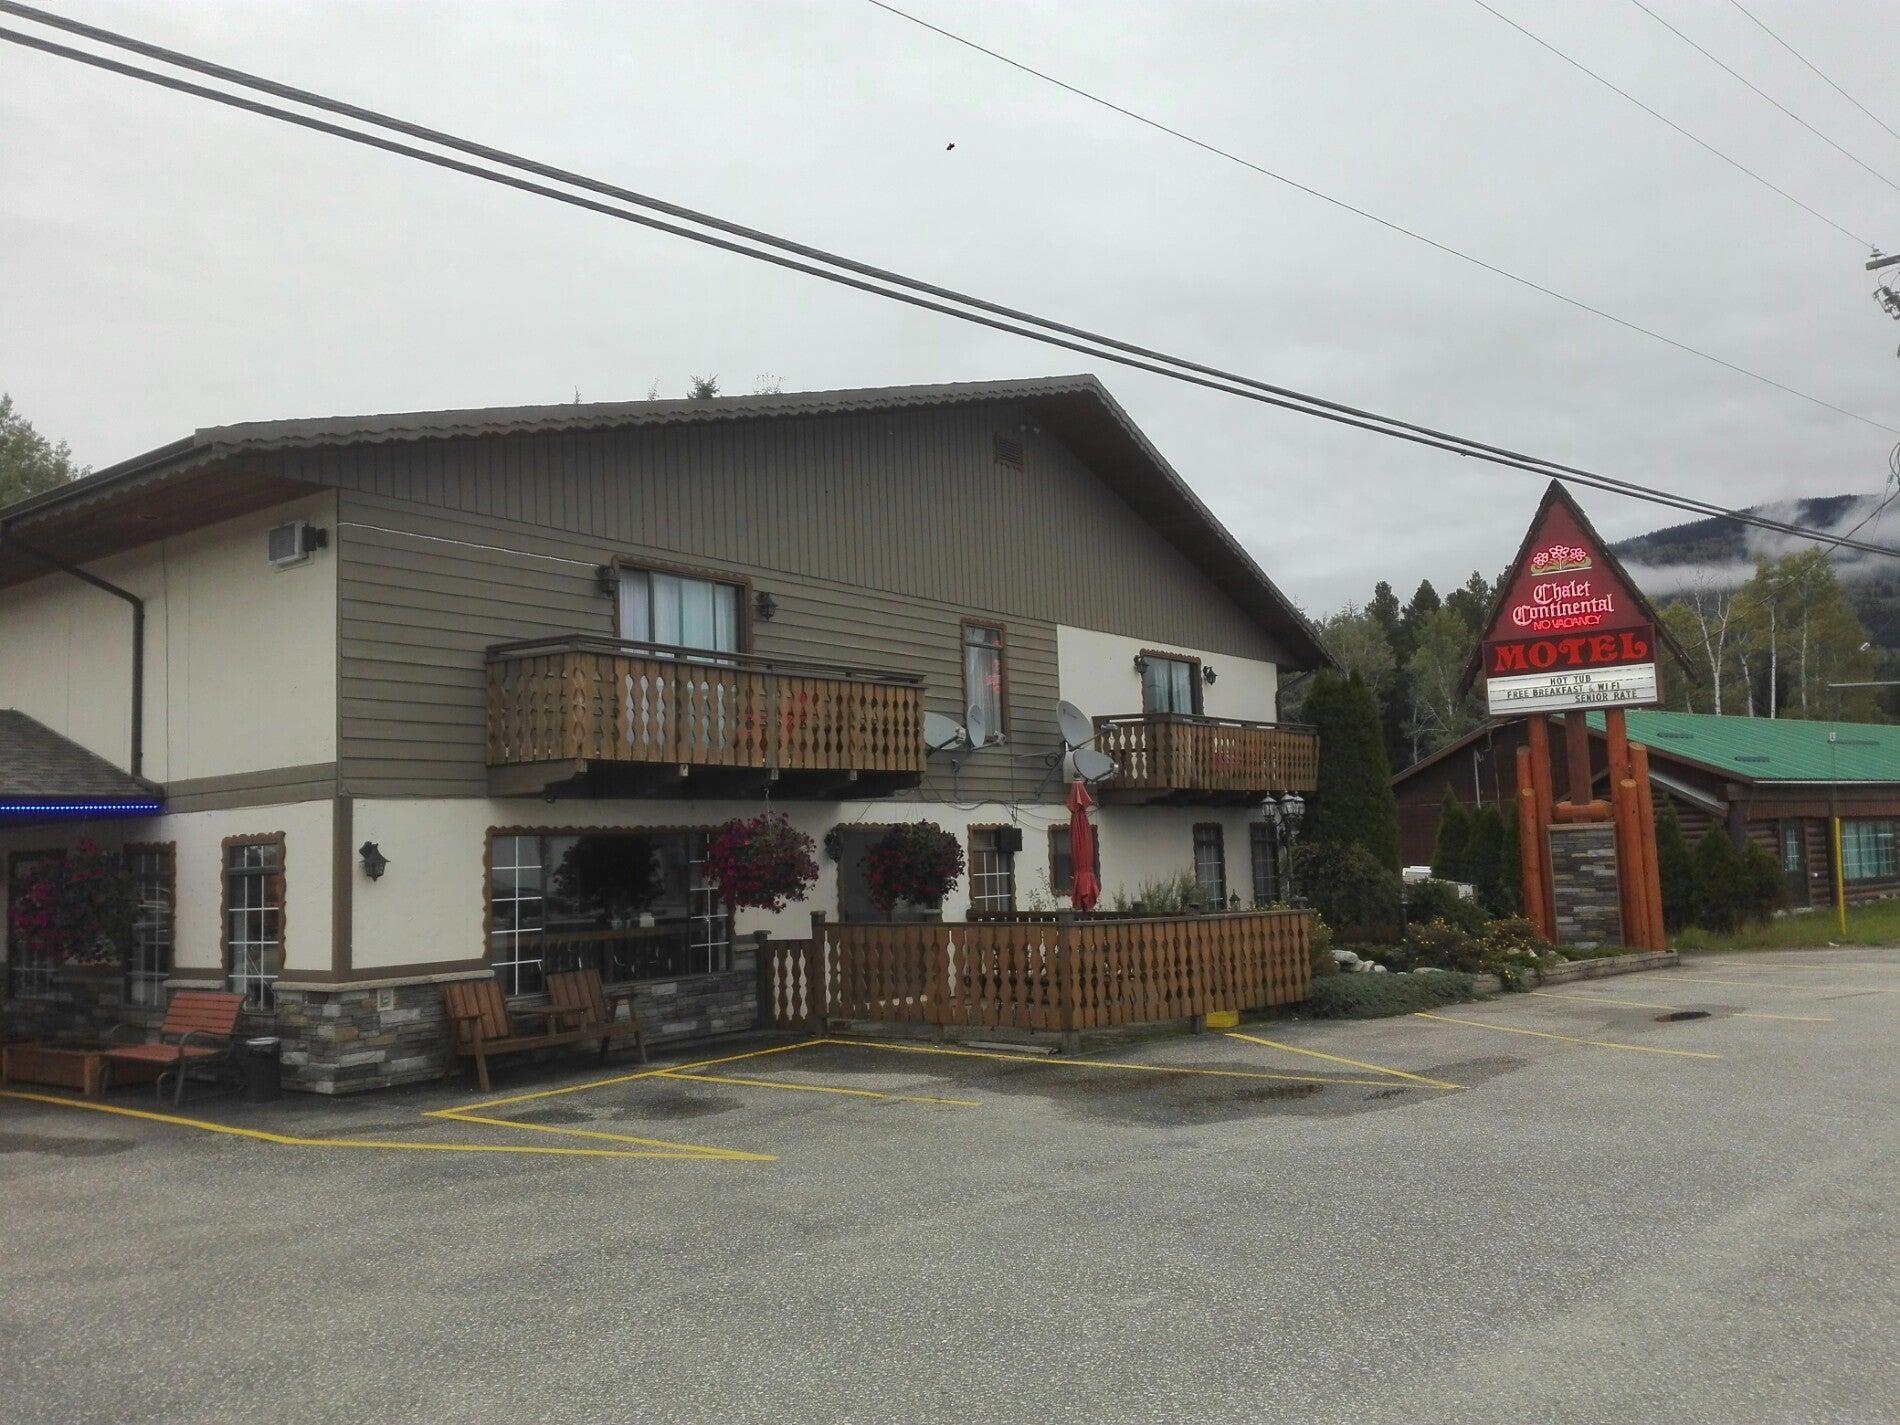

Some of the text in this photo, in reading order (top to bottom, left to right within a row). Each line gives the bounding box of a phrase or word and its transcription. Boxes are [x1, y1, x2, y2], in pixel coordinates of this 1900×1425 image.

[1533, 580, 1591, 605] Chalet
[1512, 594, 1615, 626] Continental
[1533, 614, 1602, 630] NO VACANCY
[1494, 632, 1648, 671] MOTEL
[1550, 675, 1592, 686] HOT TUB
[1507, 690, 1529, 699] FREE
[1533, 684, 1583, 697] BREAKFAST
[1575, 689, 1638, 703] SENIOR RATE
